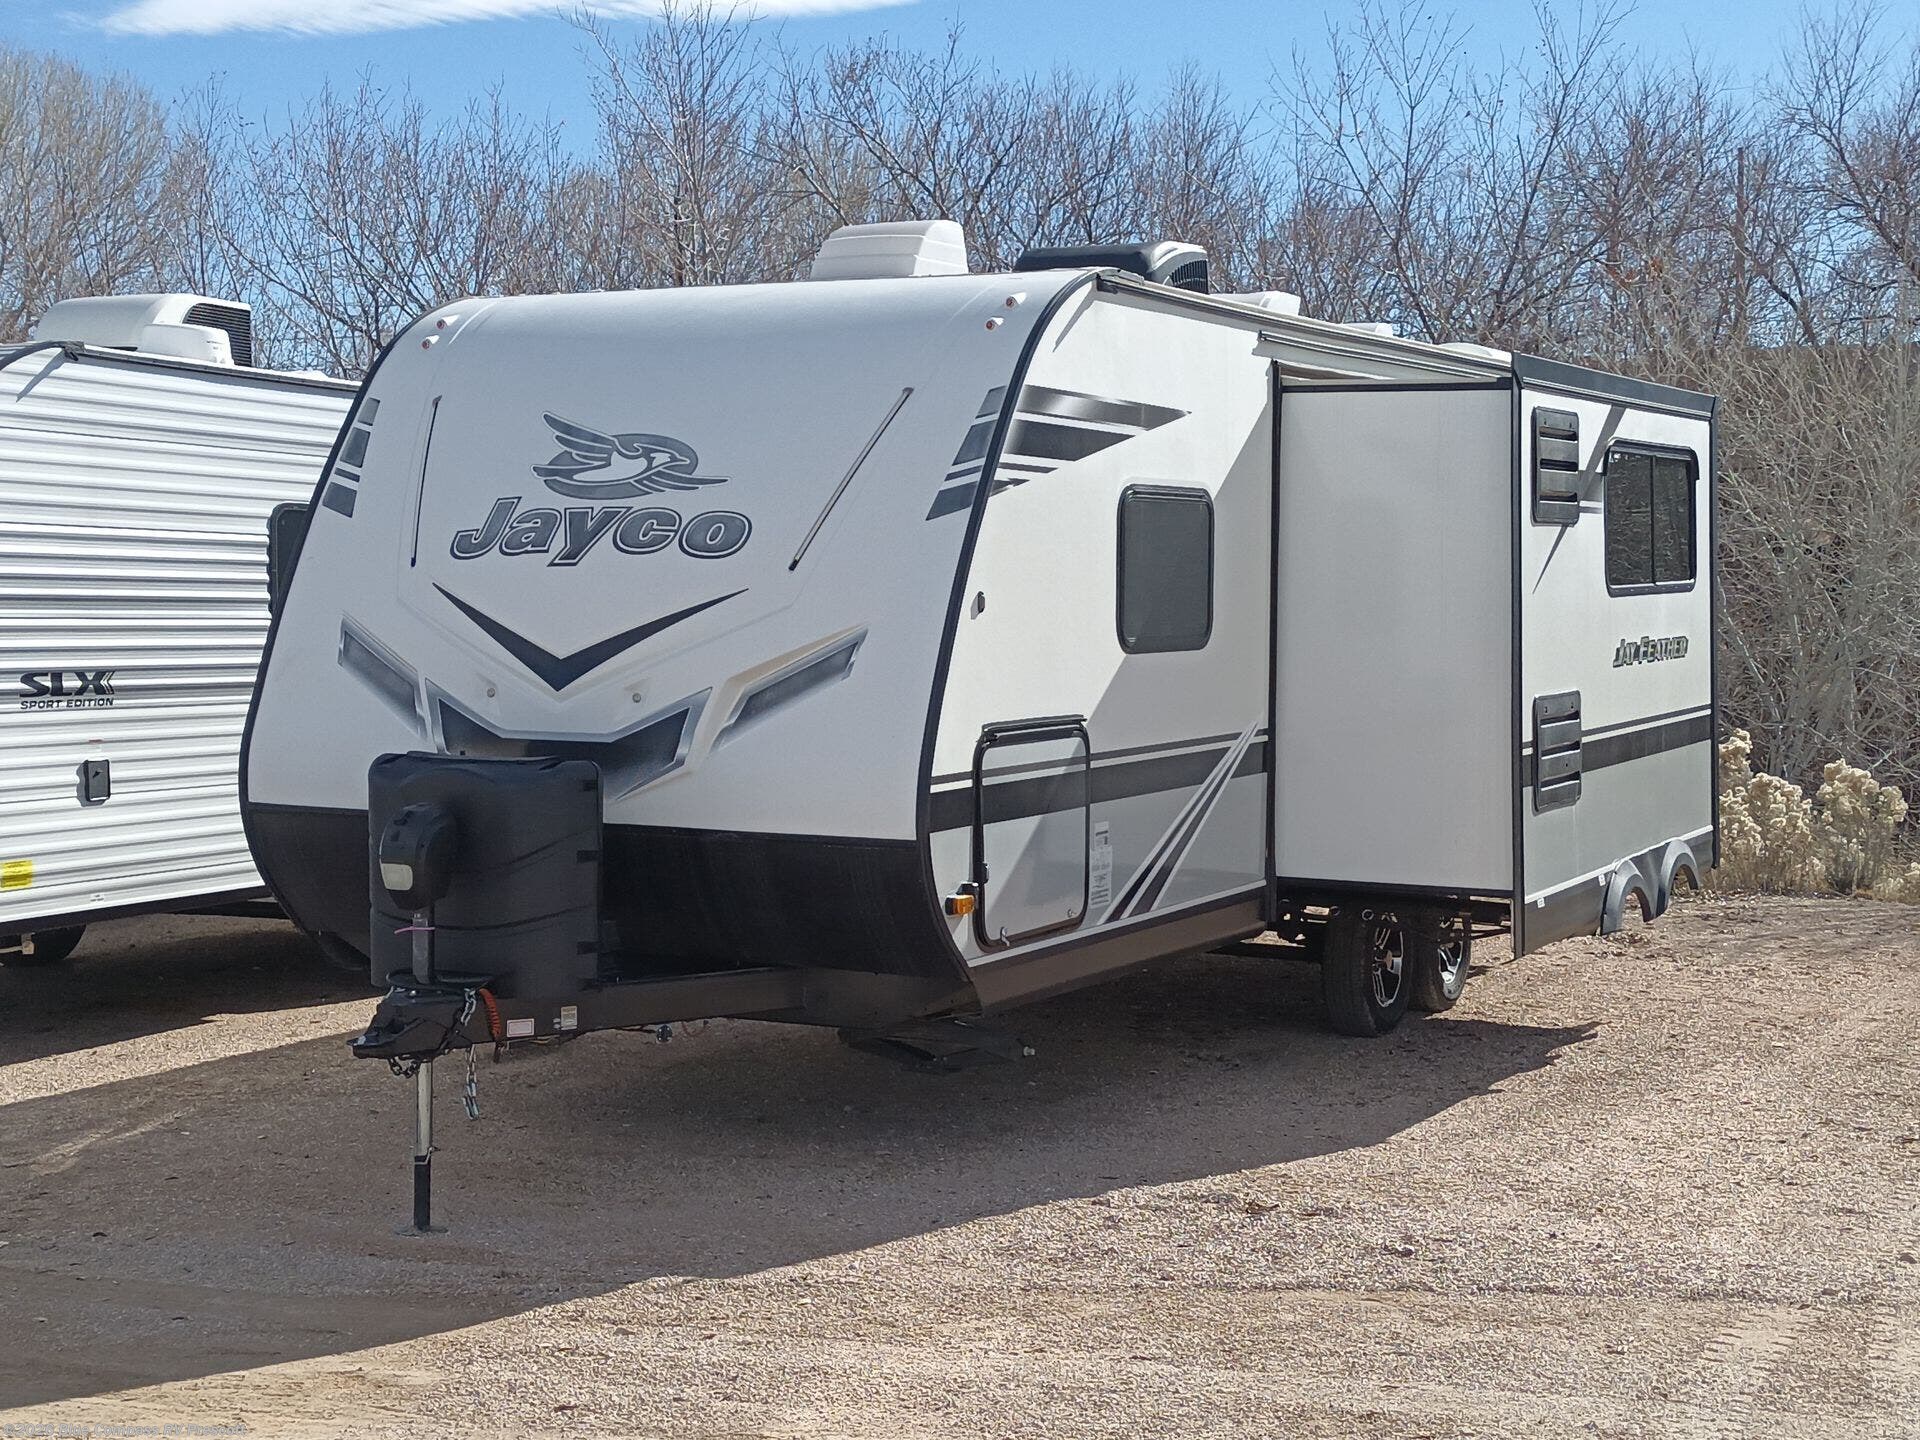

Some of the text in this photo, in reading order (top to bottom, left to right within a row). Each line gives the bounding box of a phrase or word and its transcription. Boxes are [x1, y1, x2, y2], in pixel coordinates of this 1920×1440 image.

[450, 496, 752, 567] Jayco
[19, 671, 115, 697] SLX
[20, 698, 114, 710] SPORT EDITION
